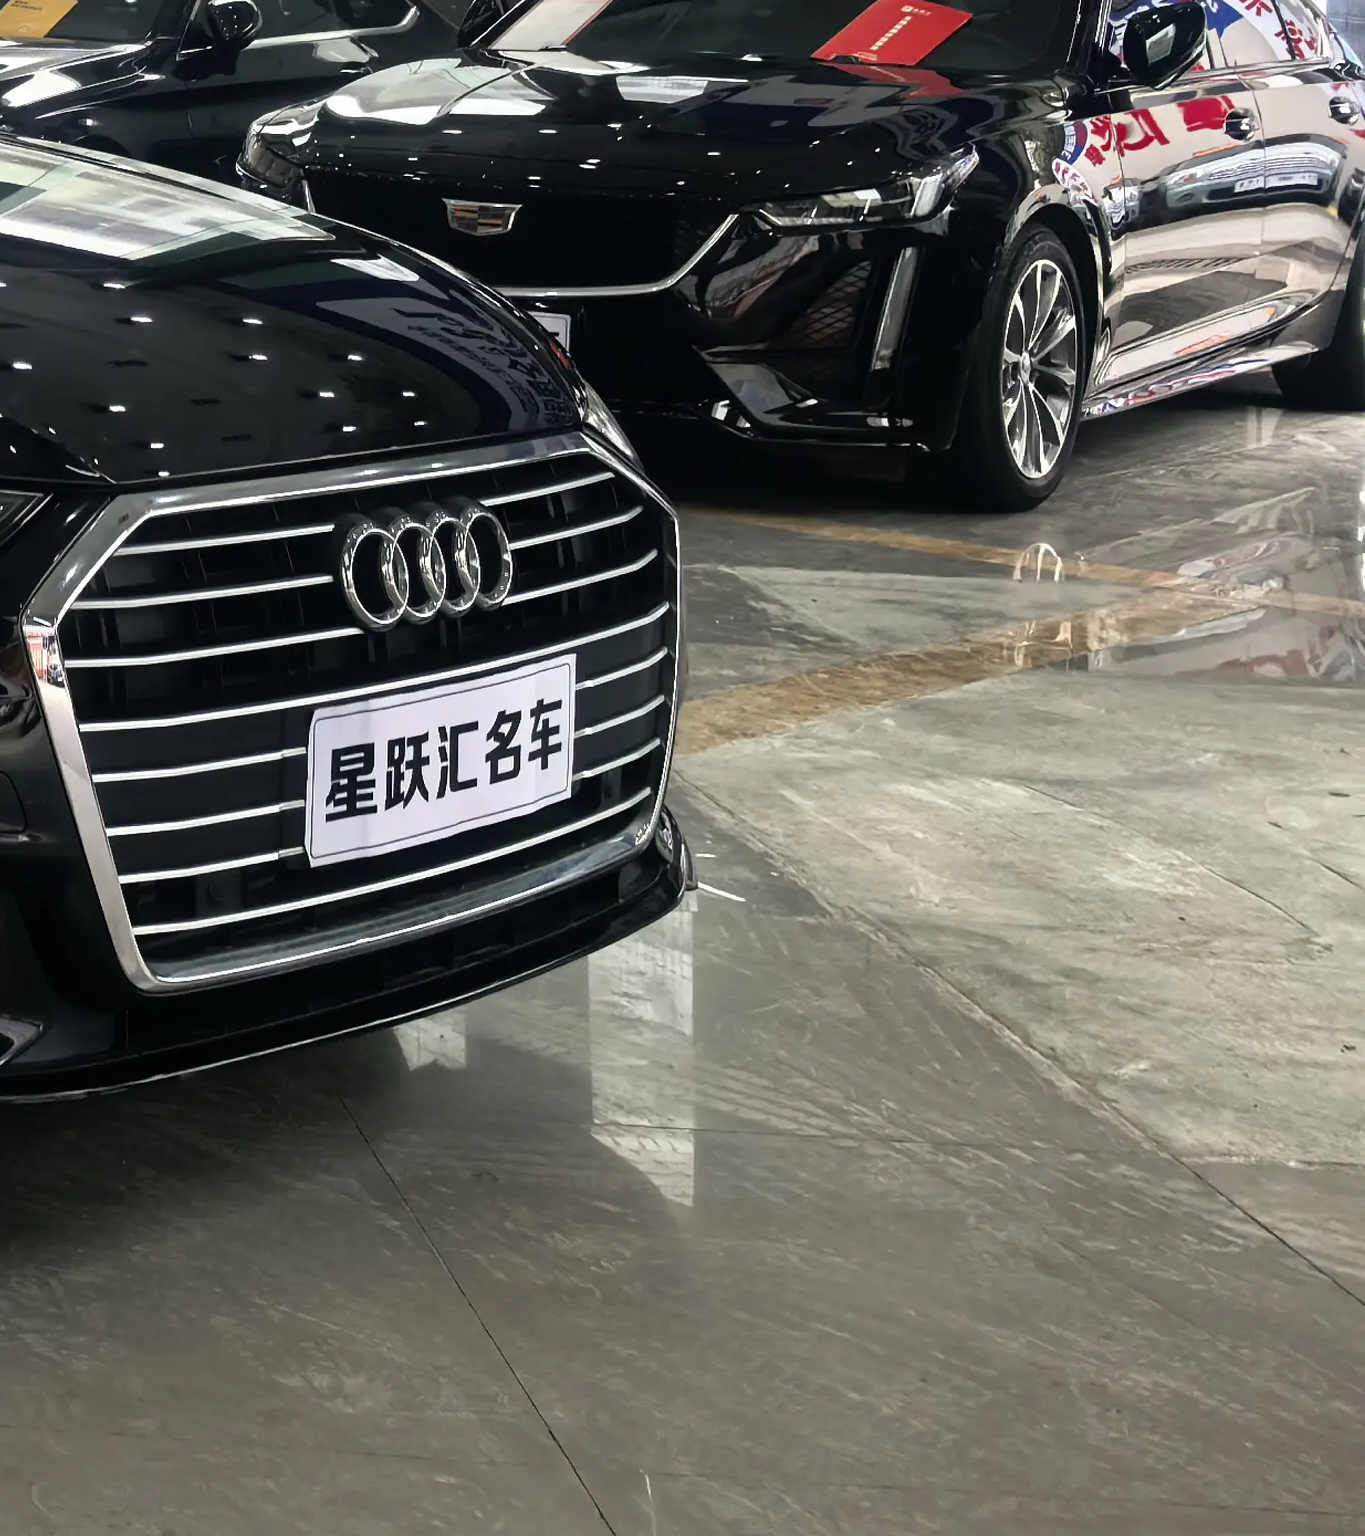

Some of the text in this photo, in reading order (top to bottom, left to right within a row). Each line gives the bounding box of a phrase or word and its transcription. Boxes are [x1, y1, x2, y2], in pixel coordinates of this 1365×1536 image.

[324, 698, 564, 823] 星跃汇名车
